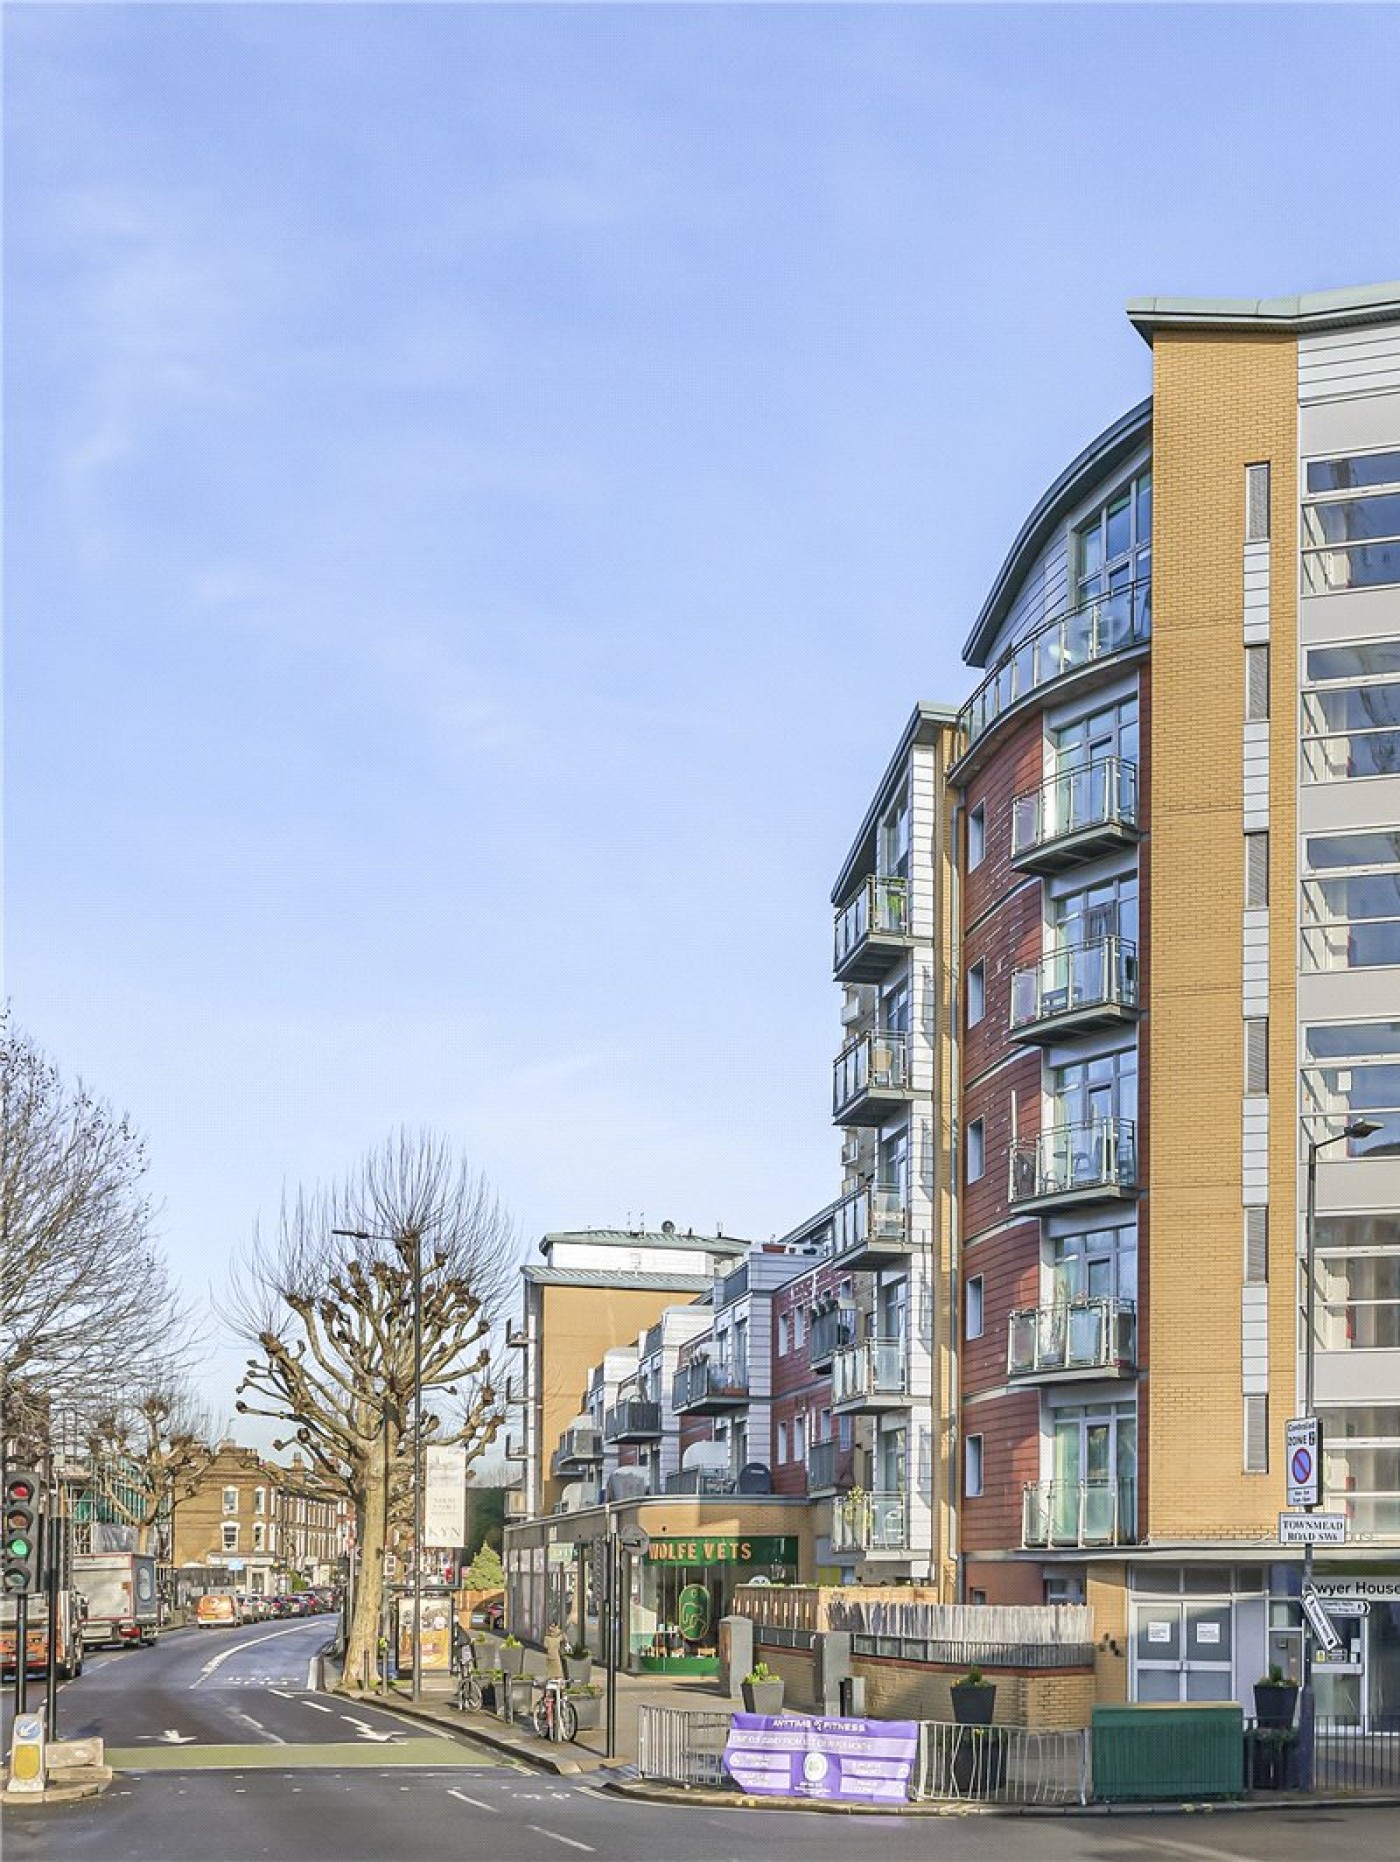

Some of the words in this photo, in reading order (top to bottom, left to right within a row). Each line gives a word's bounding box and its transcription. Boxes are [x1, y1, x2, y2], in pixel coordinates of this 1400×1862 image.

[1282, 1520, 1343, 1530] TOWNMEAD
[1287, 1532, 1316, 1541] ROAD
[703, 1542, 752, 1560] VETS
[824, 1721, 865, 1732] FITNESS
